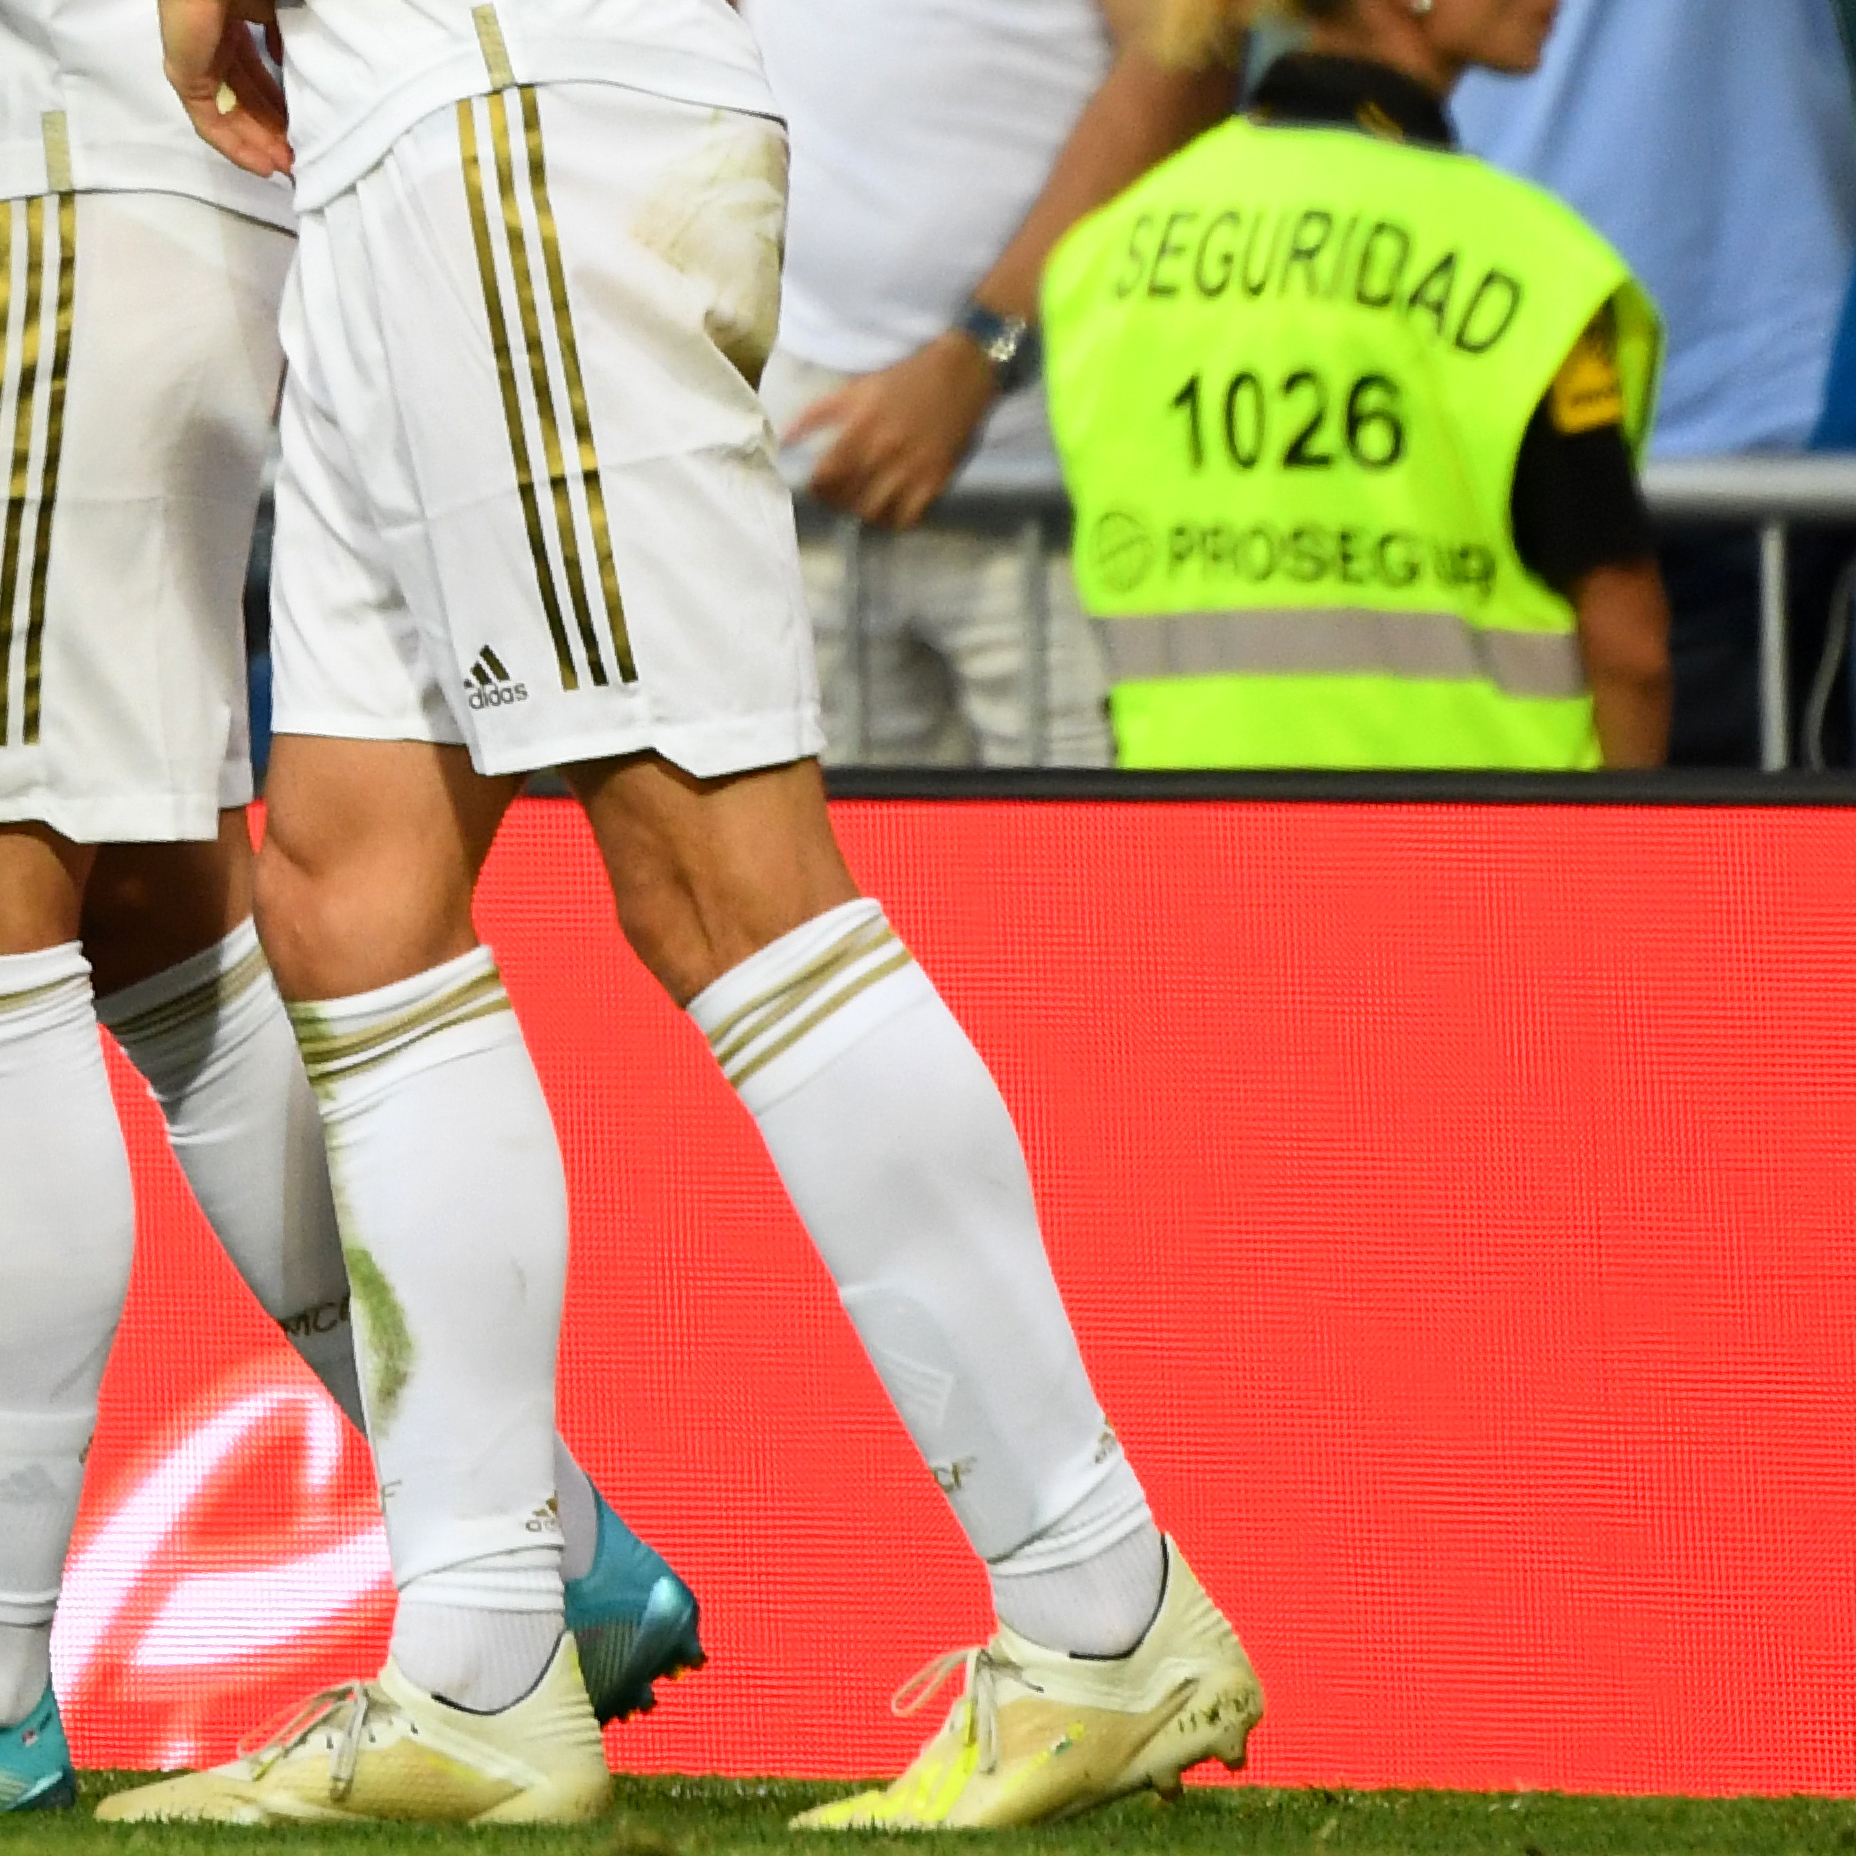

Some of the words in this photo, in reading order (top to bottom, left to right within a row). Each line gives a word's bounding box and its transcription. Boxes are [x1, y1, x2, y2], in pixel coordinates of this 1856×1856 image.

[1114, 208, 1524, 354] SEGURIDAD
[1169, 370, 1406, 470] 1026
[467, 683, 529, 710] didas
